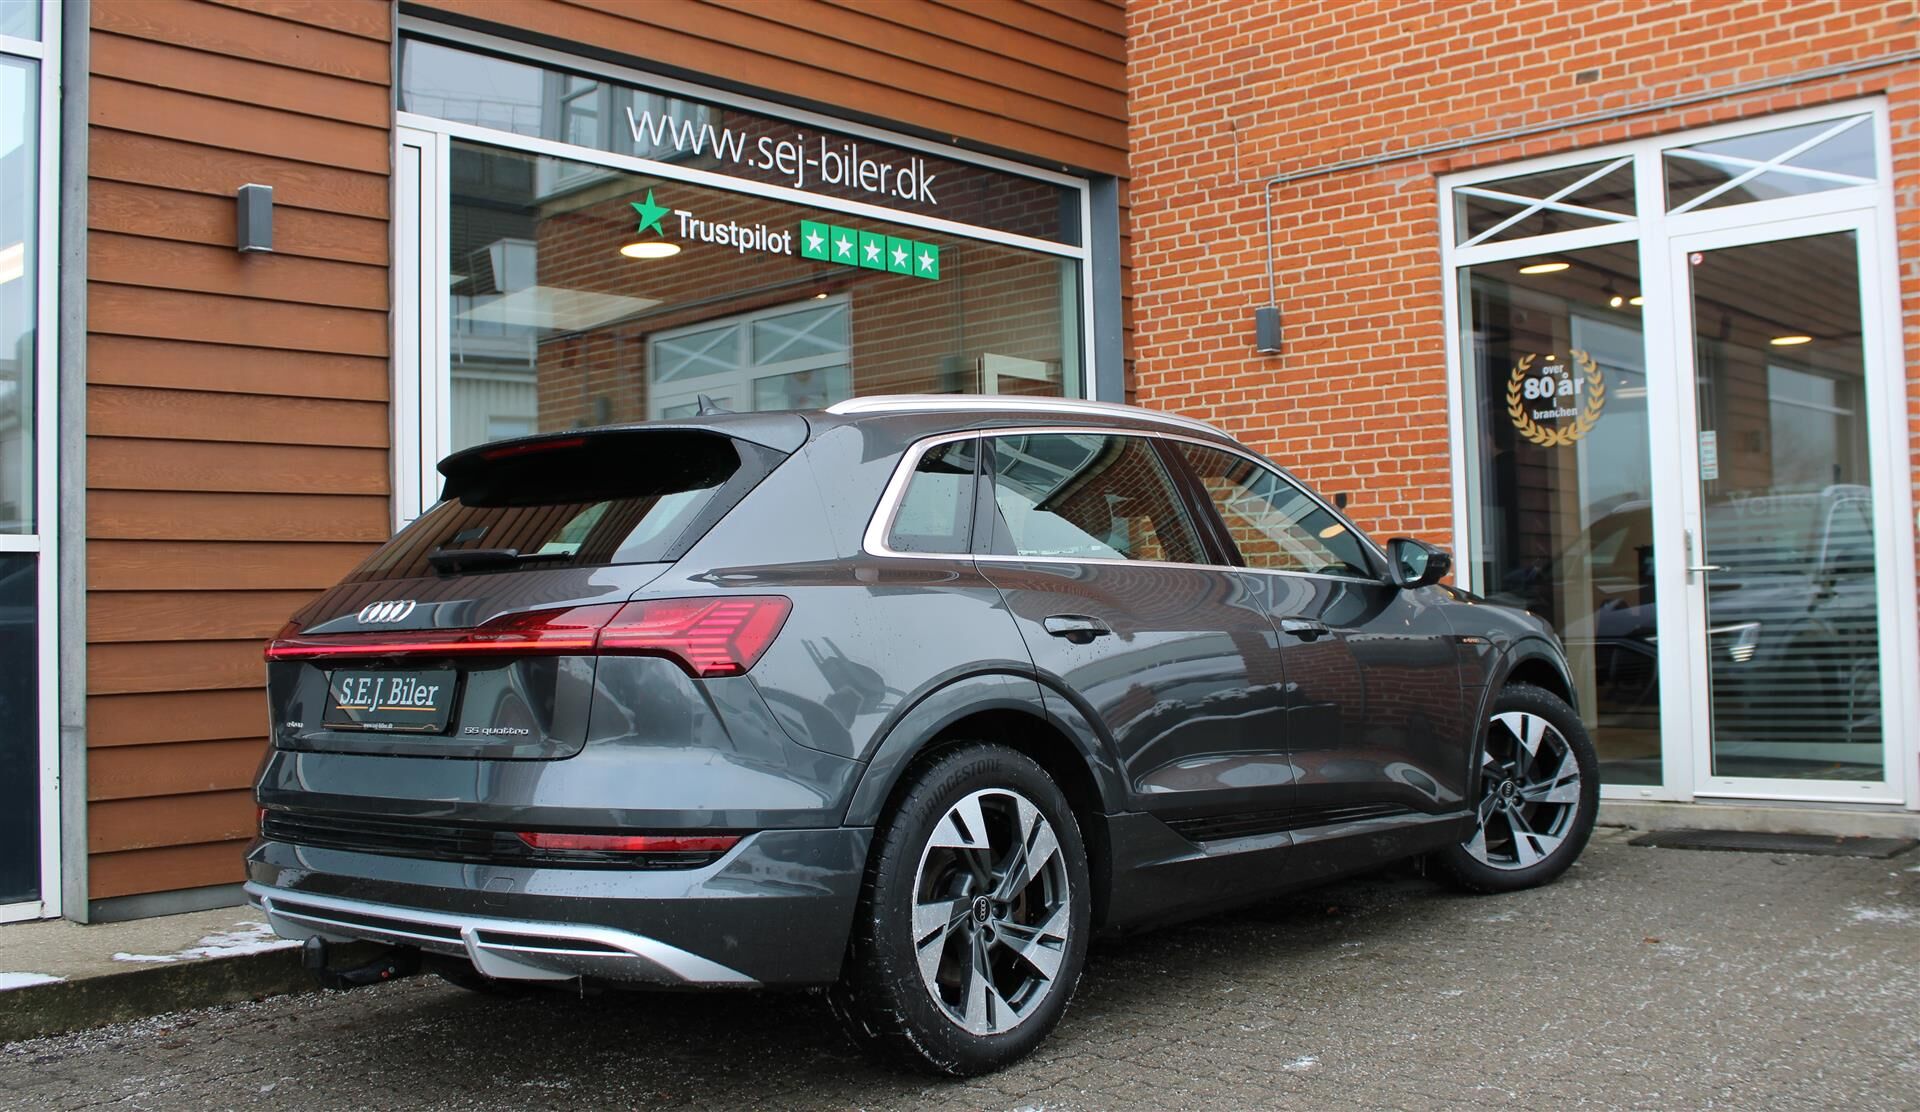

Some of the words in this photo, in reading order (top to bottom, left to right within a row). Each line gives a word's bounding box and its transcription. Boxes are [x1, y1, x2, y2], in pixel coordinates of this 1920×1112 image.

[626, 106, 938, 205] www.sej-biler.dk
[674, 209, 792, 255] Trustpilot
[1542, 365, 1564, 375] over
[1523, 376, 1555, 400] 80
[1557, 372, 1585, 396] år
[1533, 407, 1579, 420] branchen
[1553, 398, 1557, 407] i
[339, 677, 384, 712] S.E.J.
[387, 677, 439, 706] Biler
[464, 726, 481, 735] 55
[482, 726, 529, 736] quattro
[917, 758, 1002, 827] BRIDGESTONE
